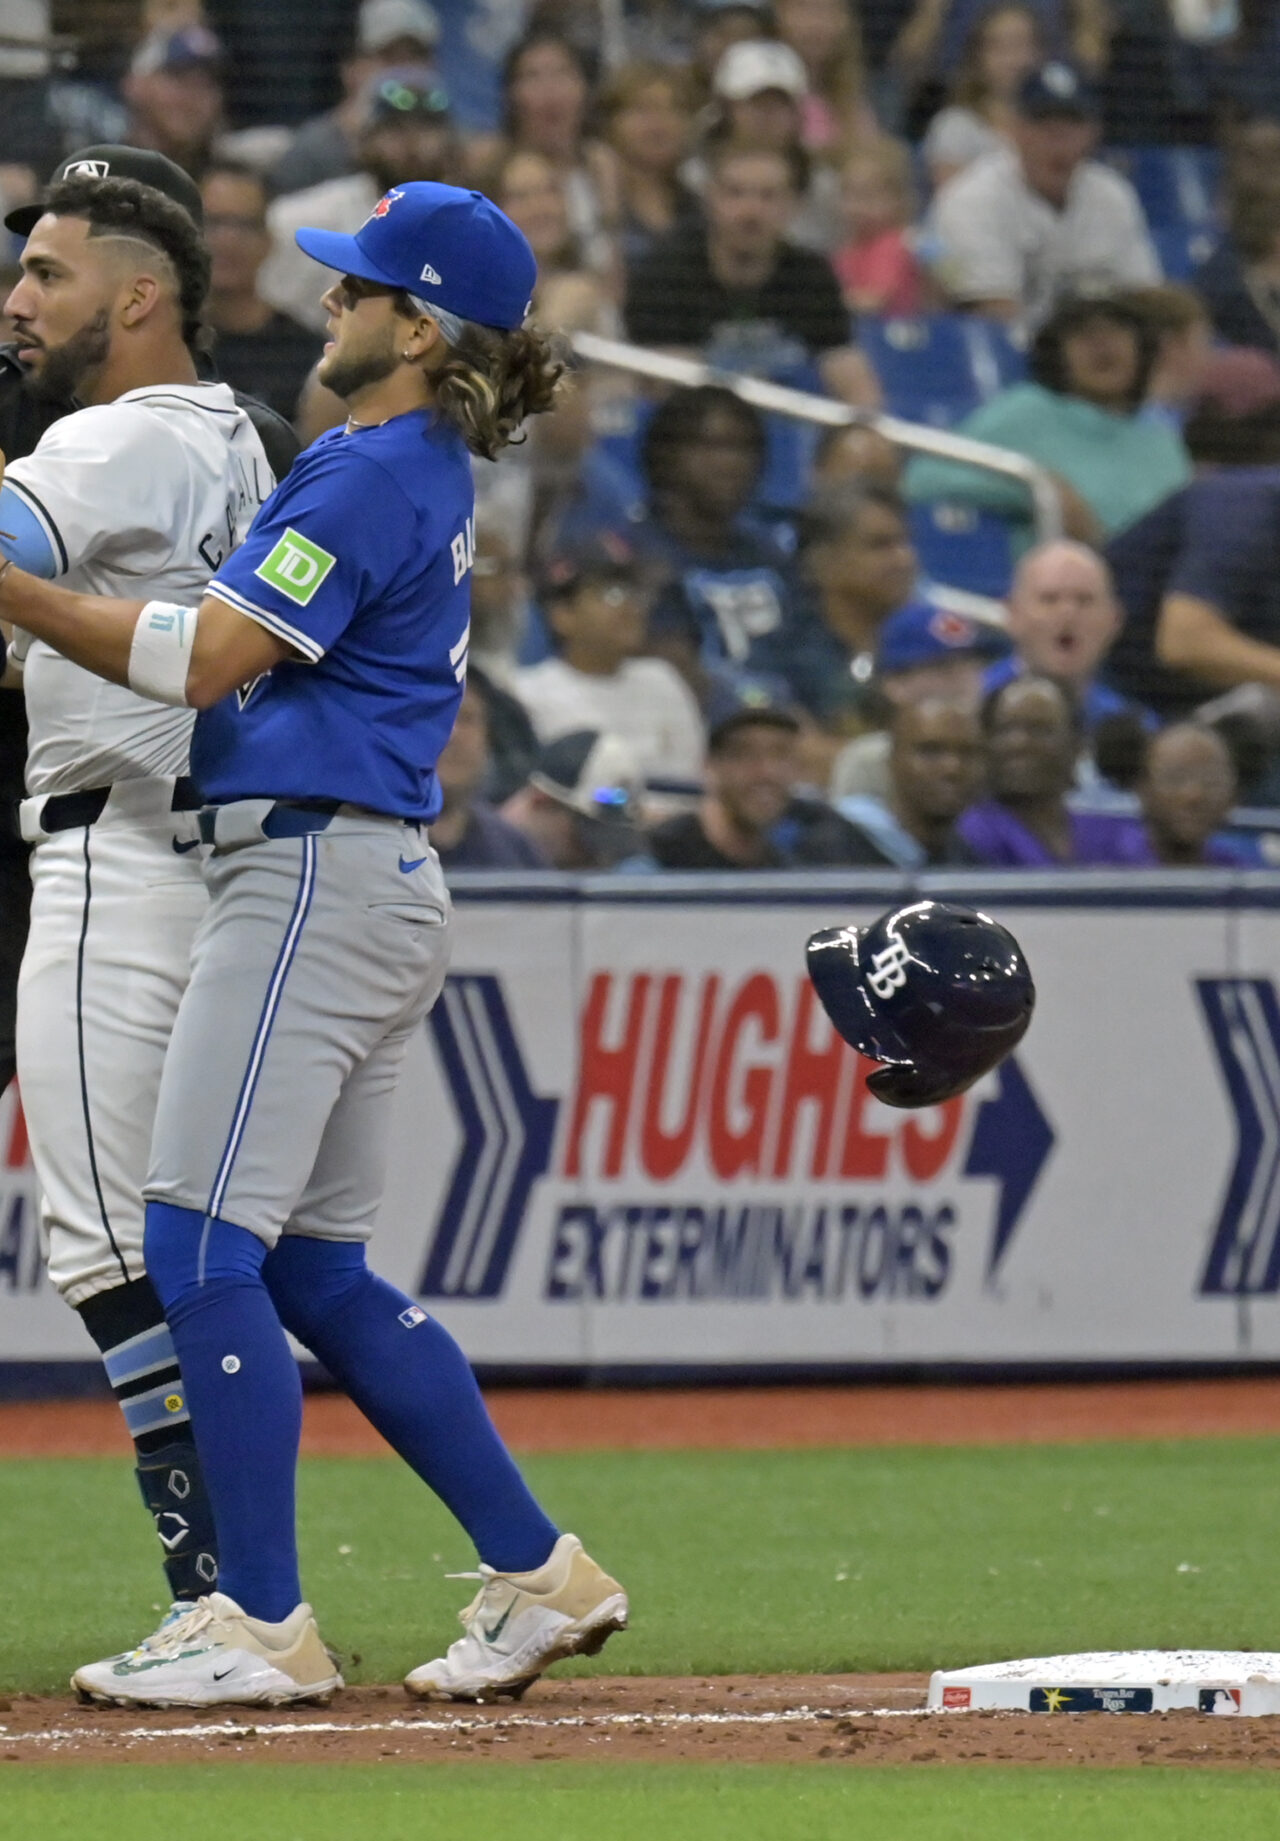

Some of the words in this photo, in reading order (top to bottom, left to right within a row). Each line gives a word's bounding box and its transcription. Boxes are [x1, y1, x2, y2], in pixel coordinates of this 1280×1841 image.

[275, 541, 319, 587] TD
[866, 932, 909, 1000] TB
[545, 1203, 956, 1300] EXTERMINATORS
